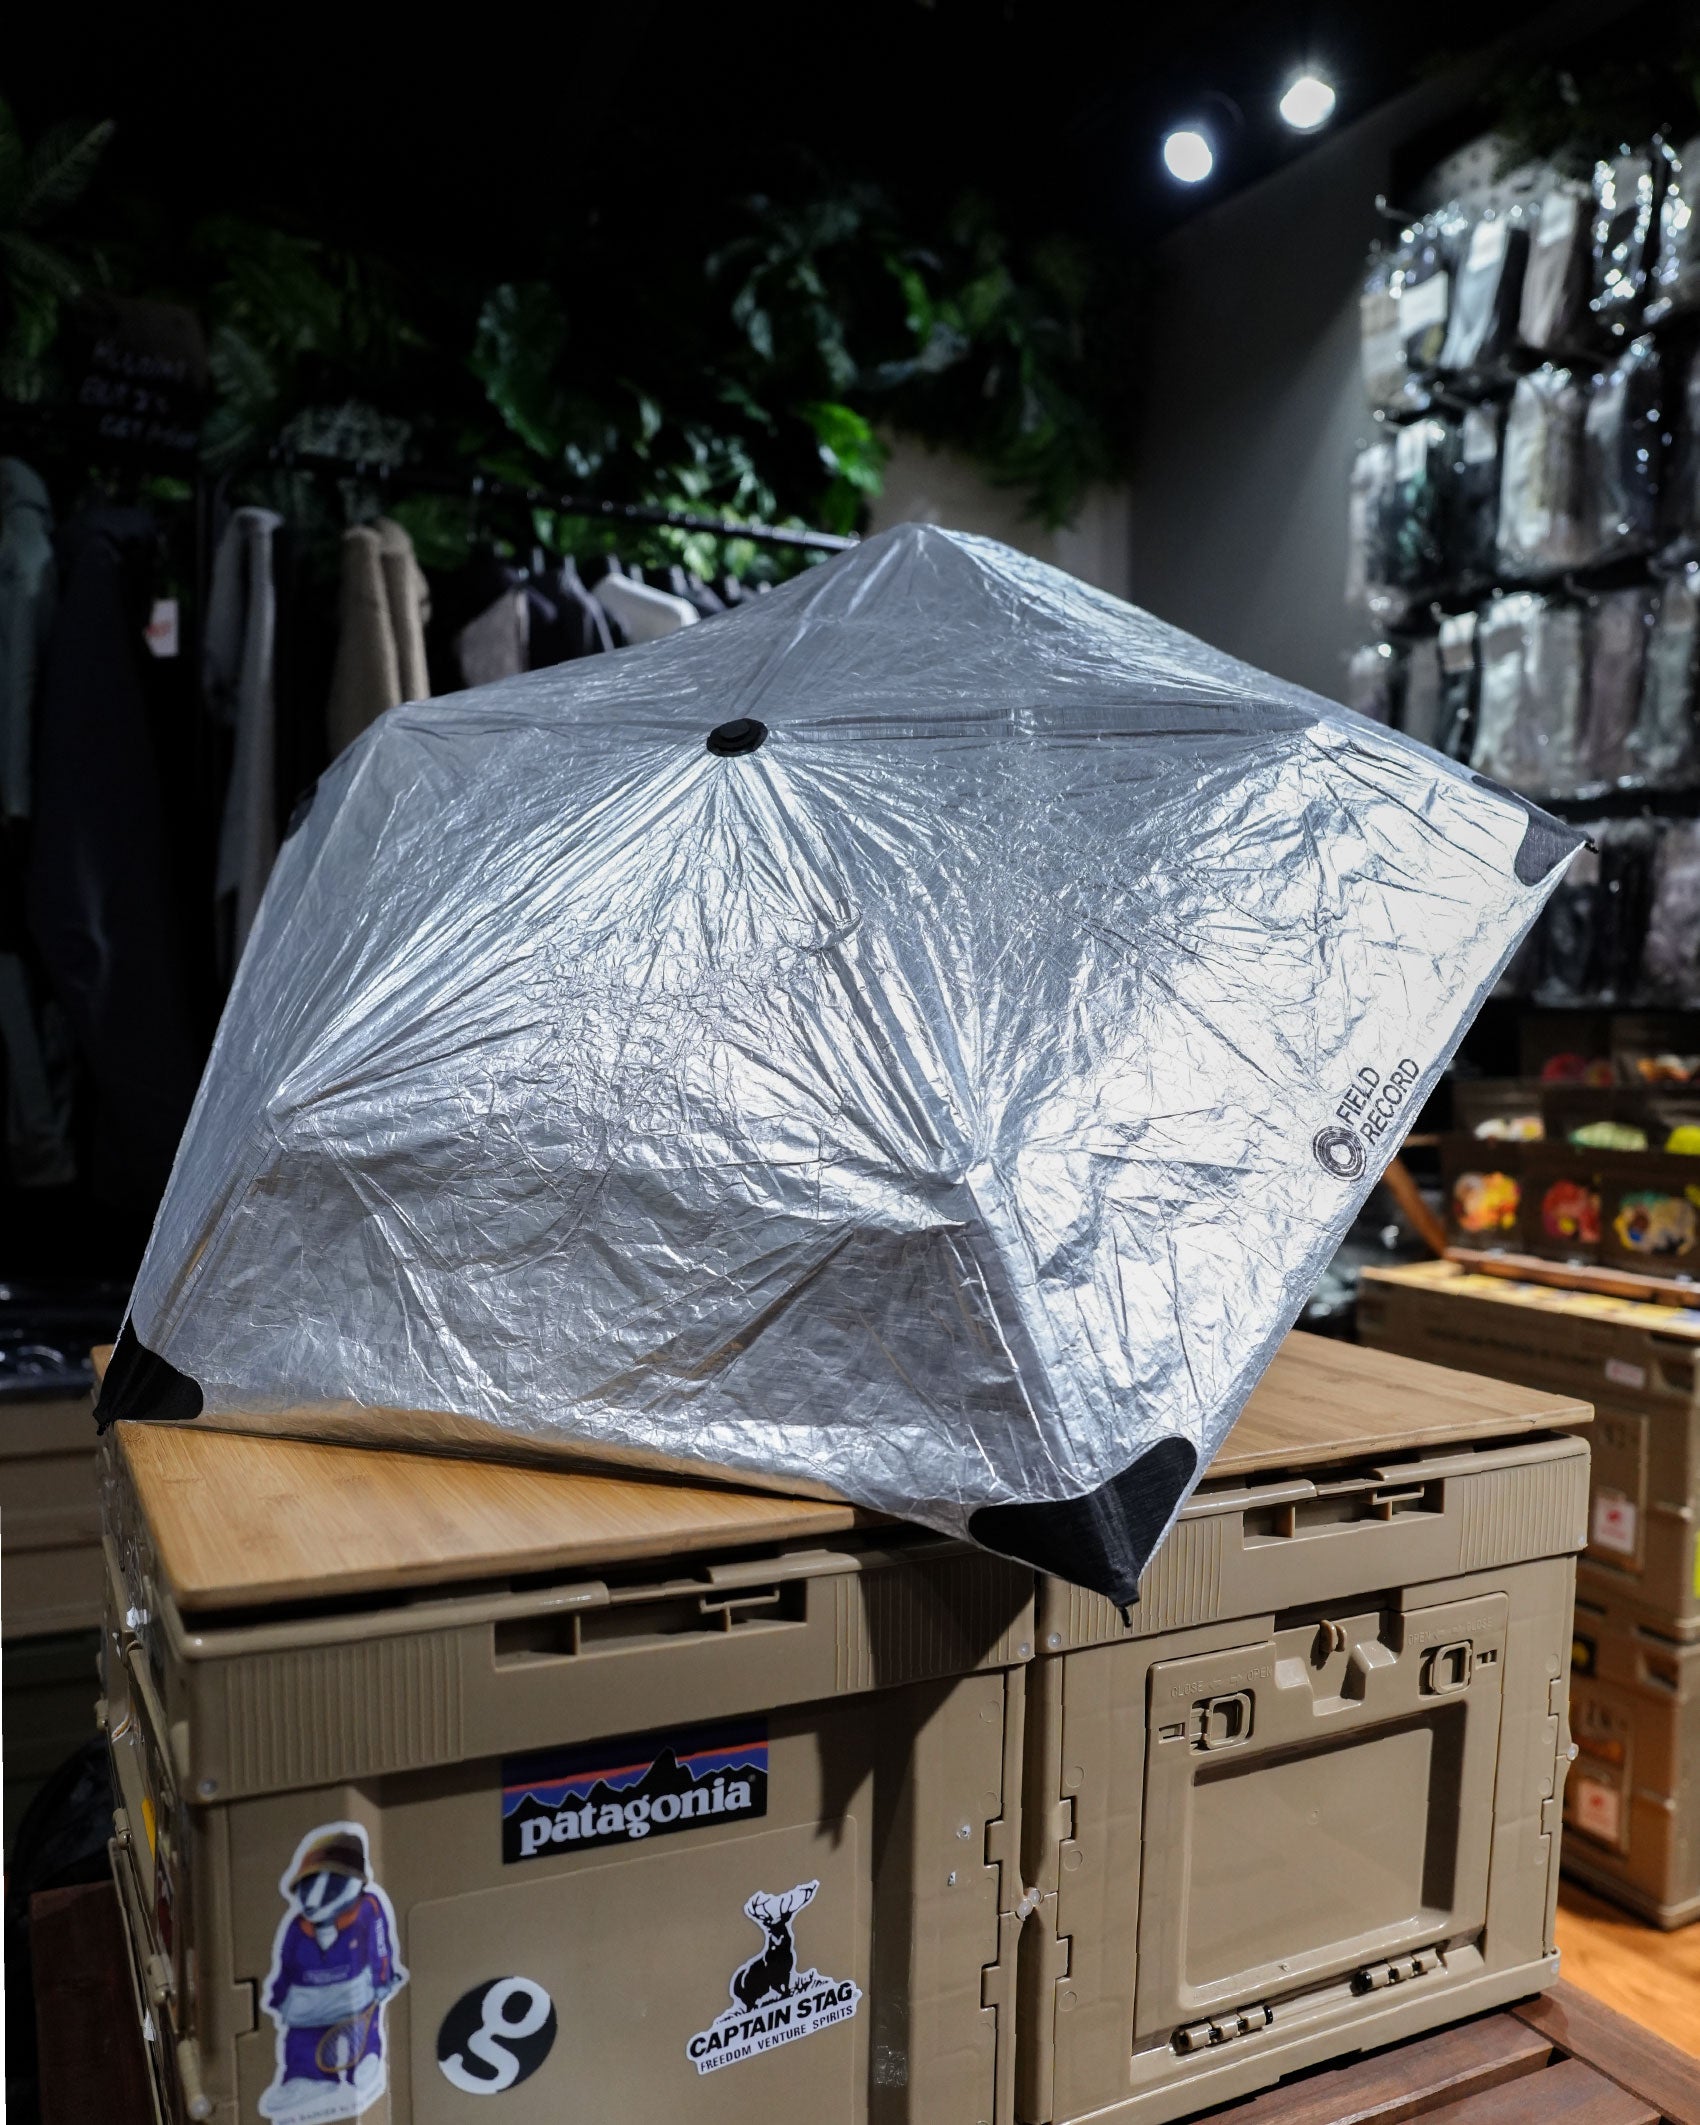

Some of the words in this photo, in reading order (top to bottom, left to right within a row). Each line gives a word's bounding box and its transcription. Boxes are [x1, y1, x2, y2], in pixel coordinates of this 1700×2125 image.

[1336, 1067, 1380, 1126] FIELD
[1360, 1059, 1419, 1146] RECORD
[1171, 1680, 1205, 1697] CLOSE
[1247, 1665, 1273, 1681] OPEN
[520, 1777, 752, 1856] patagonia
[689, 2006, 791, 2058] CAPTAIN
[797, 1983, 853, 2019] STAG
[700, 2046, 752, 2073] FREEDOM
[757, 2024, 807, 2050] VENTURE
[812, 2005, 853, 2030] SPIRITS
